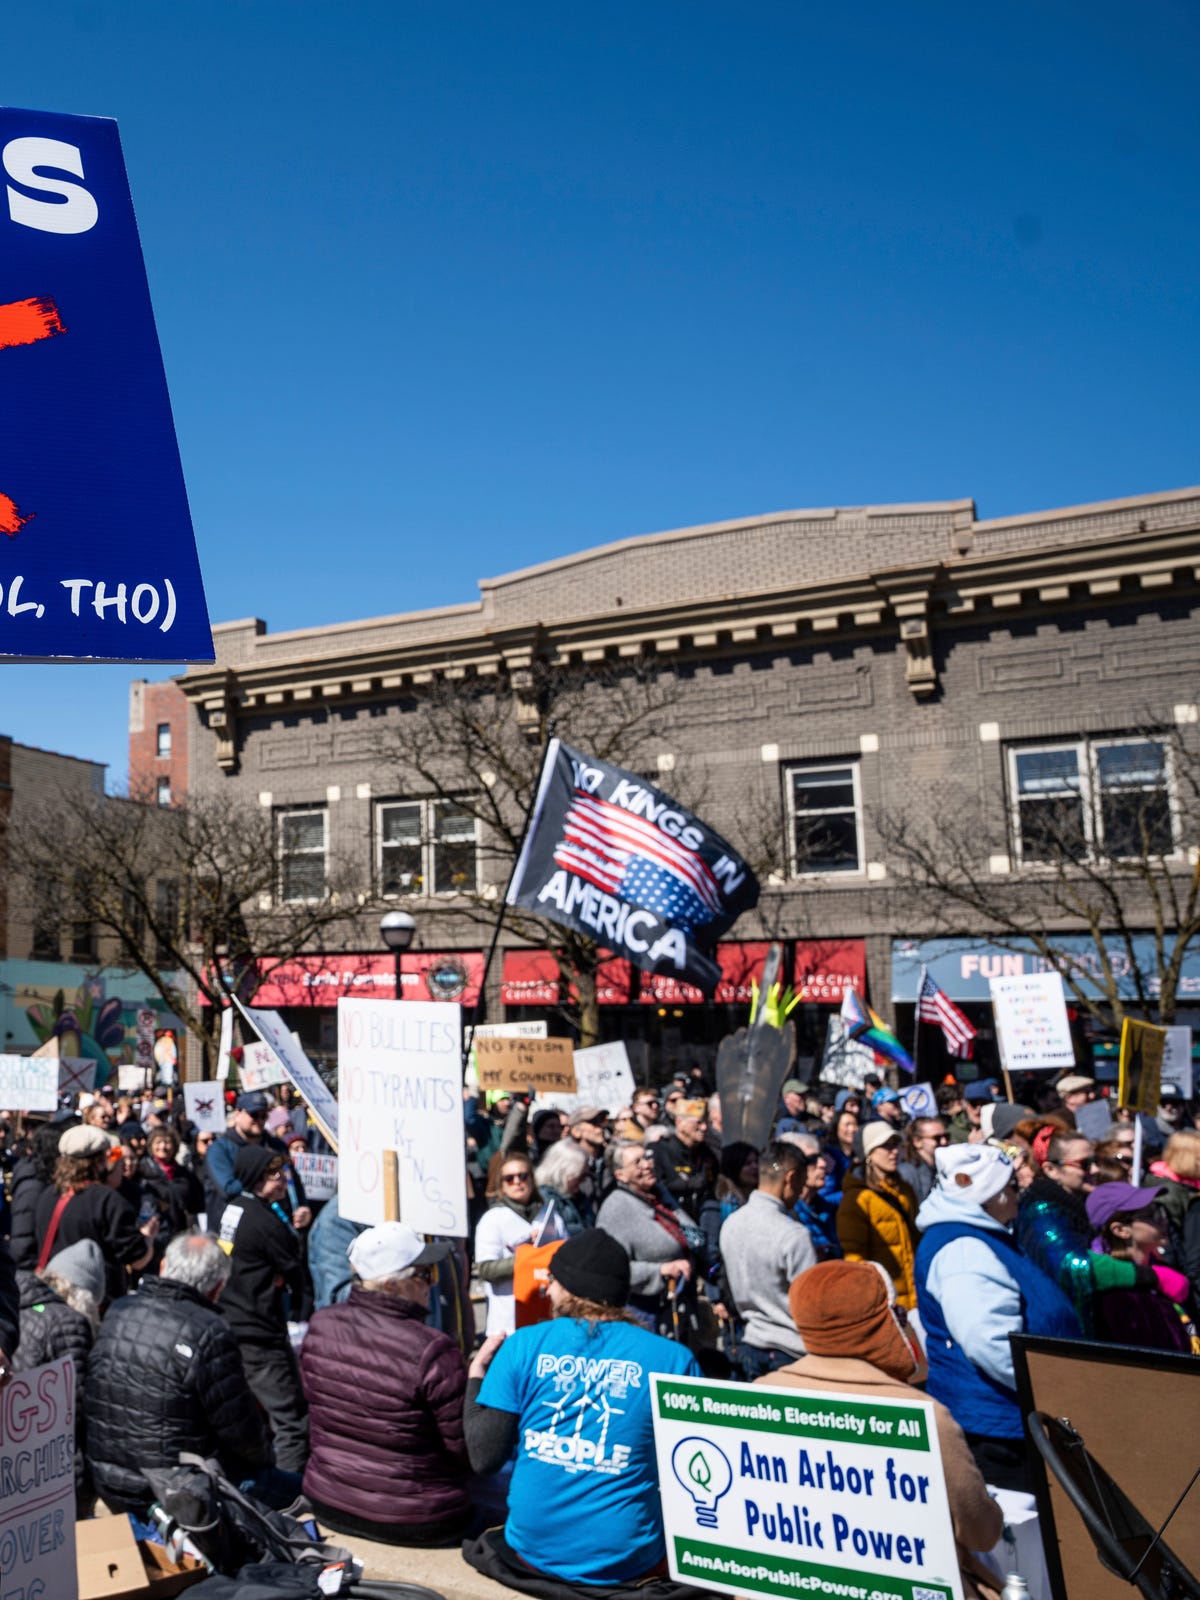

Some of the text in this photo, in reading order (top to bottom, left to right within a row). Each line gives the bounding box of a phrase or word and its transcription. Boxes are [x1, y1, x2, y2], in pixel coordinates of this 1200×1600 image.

[60, 578, 177, 633] THO)
[608, 779, 705, 851] KINGS
[711, 854, 746, 896] IN
[537, 870, 687, 970] AMERICA
[960, 953, 1024, 980] FUN
[343, 1010, 456, 1054] NO BULLIES
[479, 1040, 502, 1054] NO
[483, 1070, 573, 1087] MY COUNTRY
[518, 1055, 534, 1065] IN
[343, 1066, 365, 1103] NO
[368, 1069, 455, 1114] TYRANTS
[537, 1354, 642, 1388] POWER
[553, 1376, 577, 1392] TO
[662, 1391, 921, 1438] 100% Renewable Electricity for All
[524, 1429, 632, 1469] PEOPLE
[740, 1441, 929, 1504] Ann Arbor for
[745, 1499, 926, 1567] Public Power
